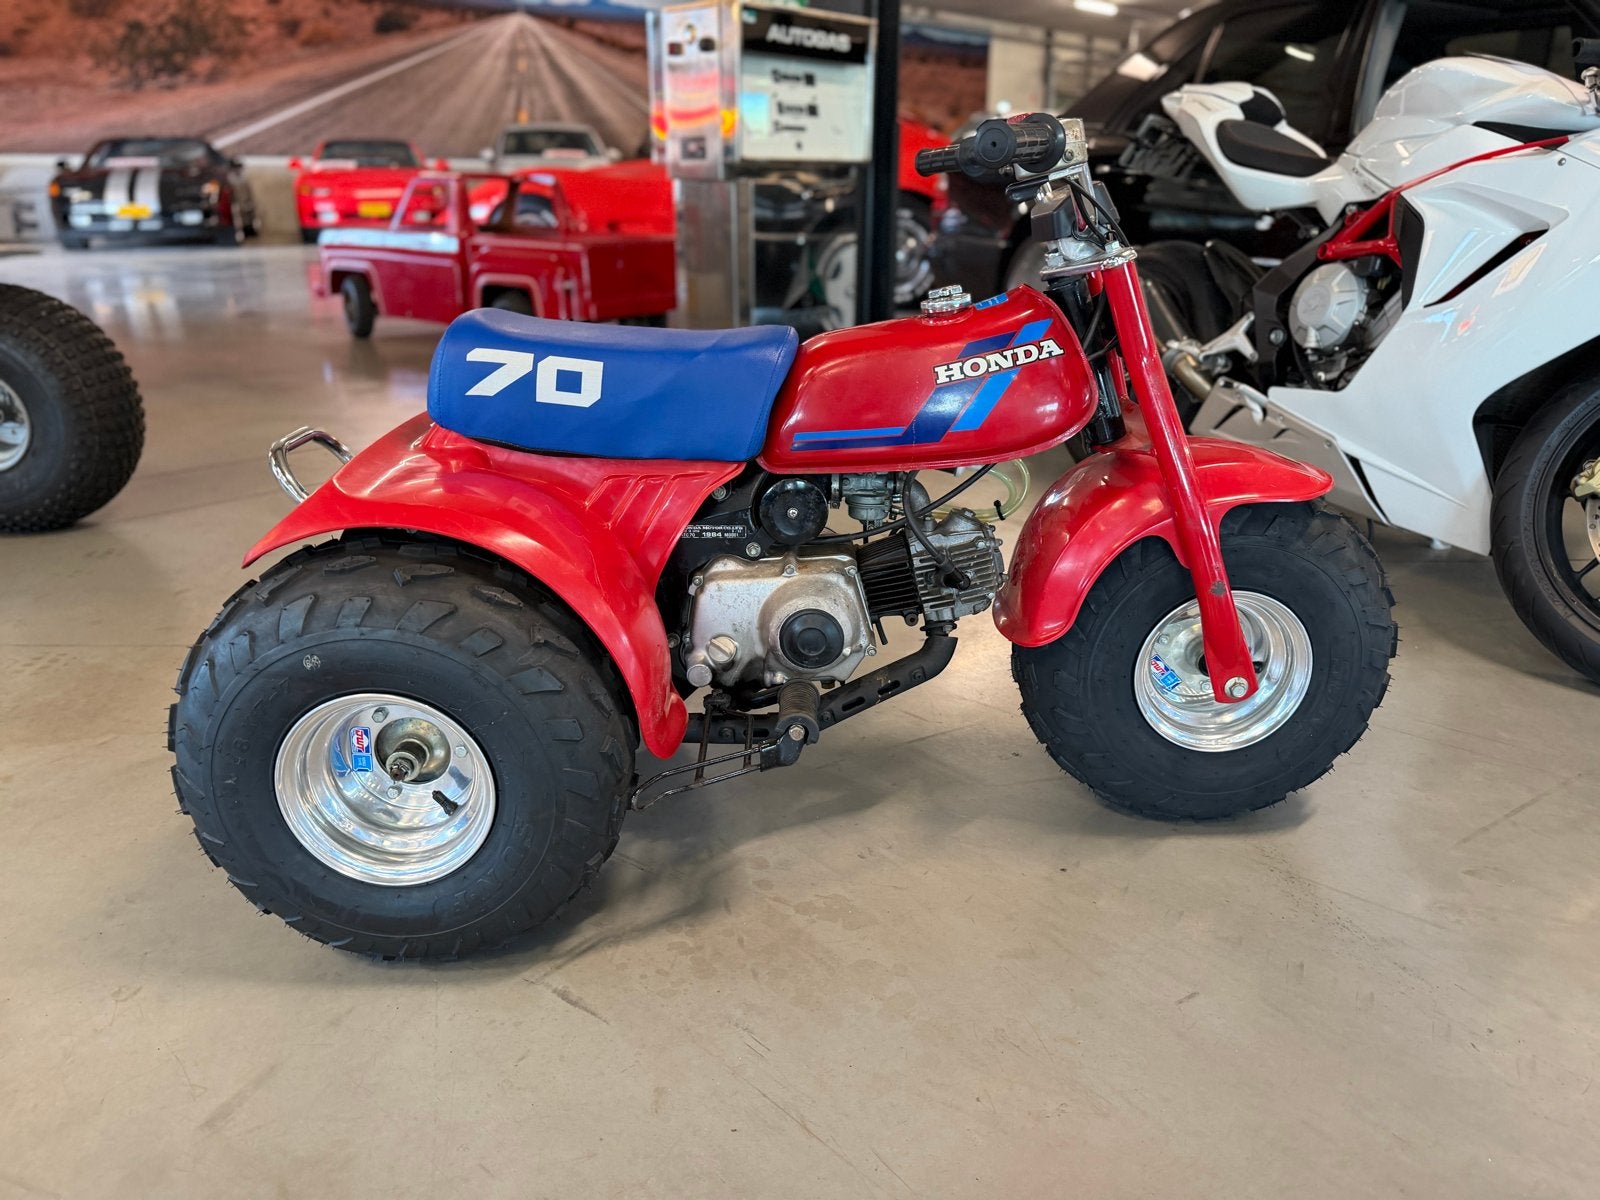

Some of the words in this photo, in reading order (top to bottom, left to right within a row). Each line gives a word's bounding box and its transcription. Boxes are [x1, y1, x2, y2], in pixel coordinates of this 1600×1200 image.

[766, 23, 852, 54] AUTOGAS
[464, 347, 604, 408] 70
[933, 338, 1065, 386] HONDA
